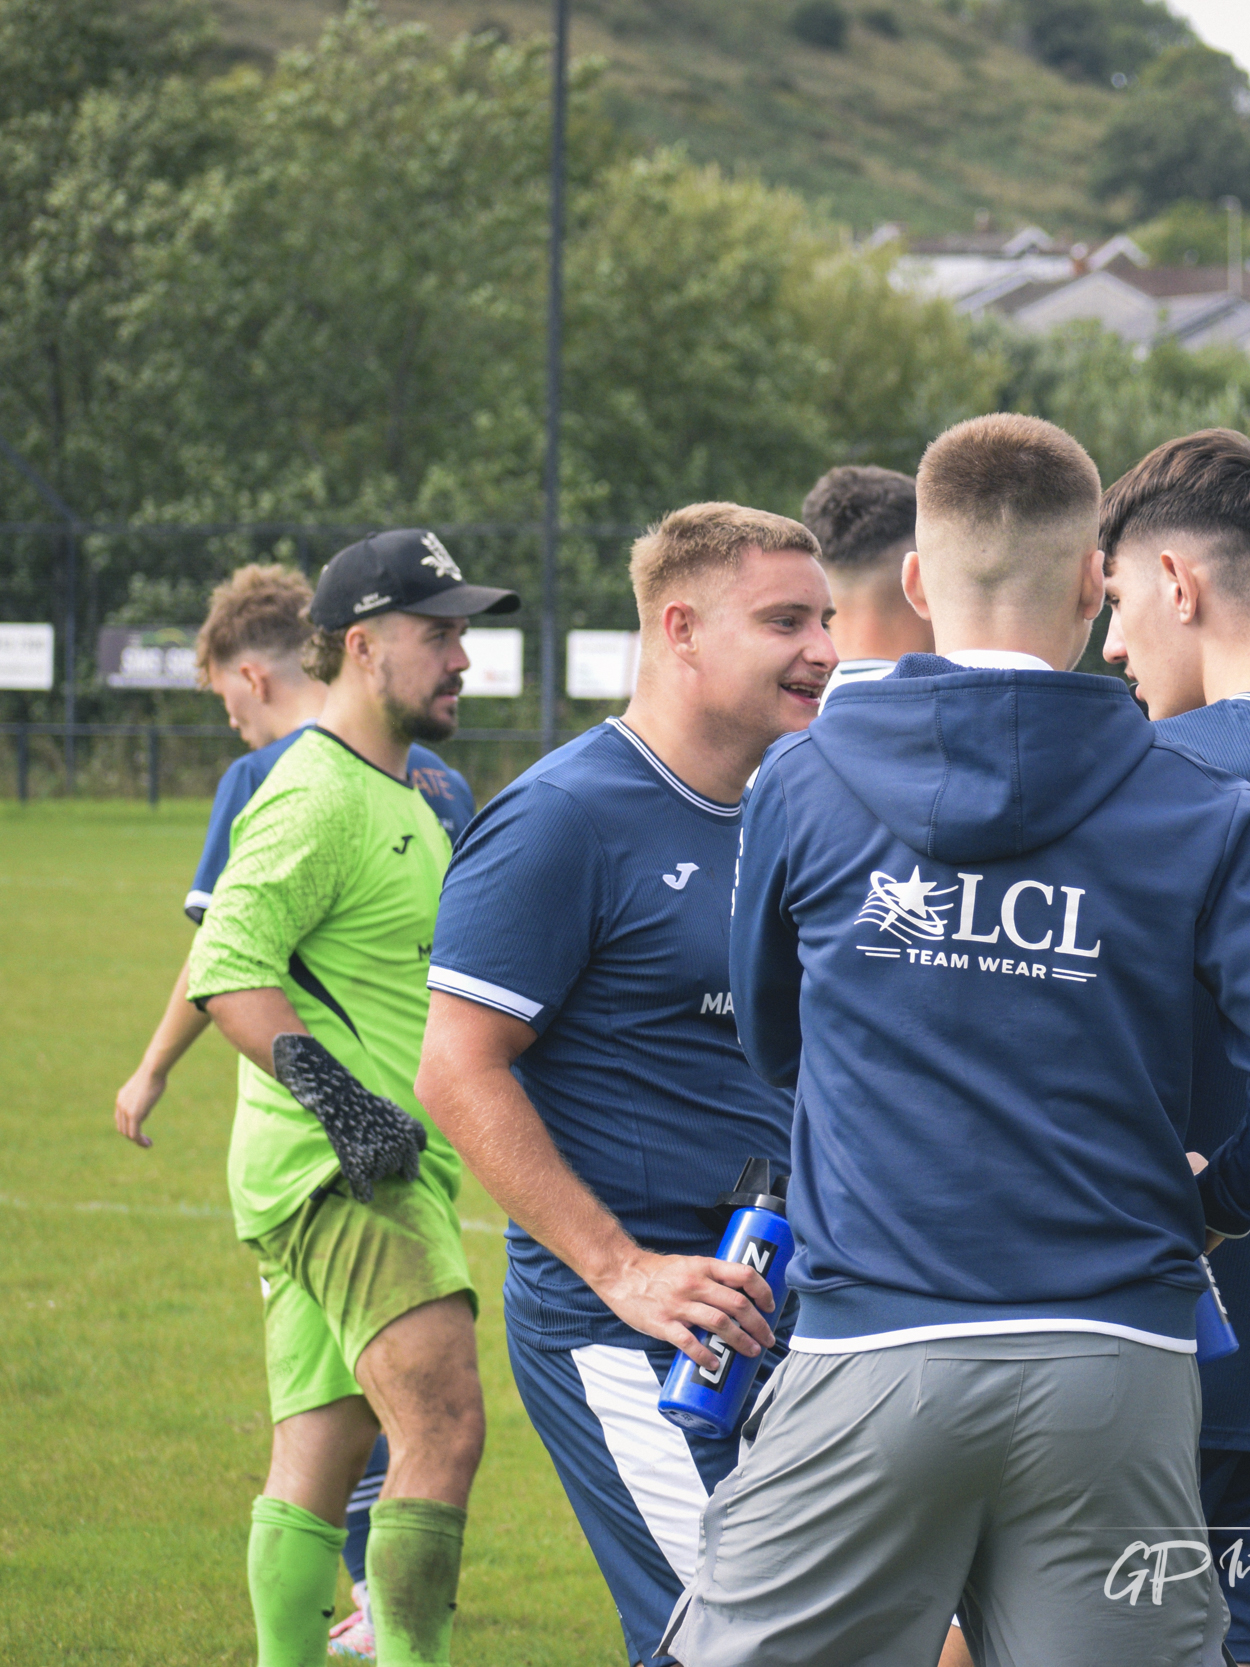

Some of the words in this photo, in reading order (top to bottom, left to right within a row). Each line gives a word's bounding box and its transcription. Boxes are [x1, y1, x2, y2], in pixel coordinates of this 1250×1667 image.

[951, 872, 1101, 958] LCL
[906, 948, 969, 970] TEAM
[978, 956, 1047, 979] WEAR
